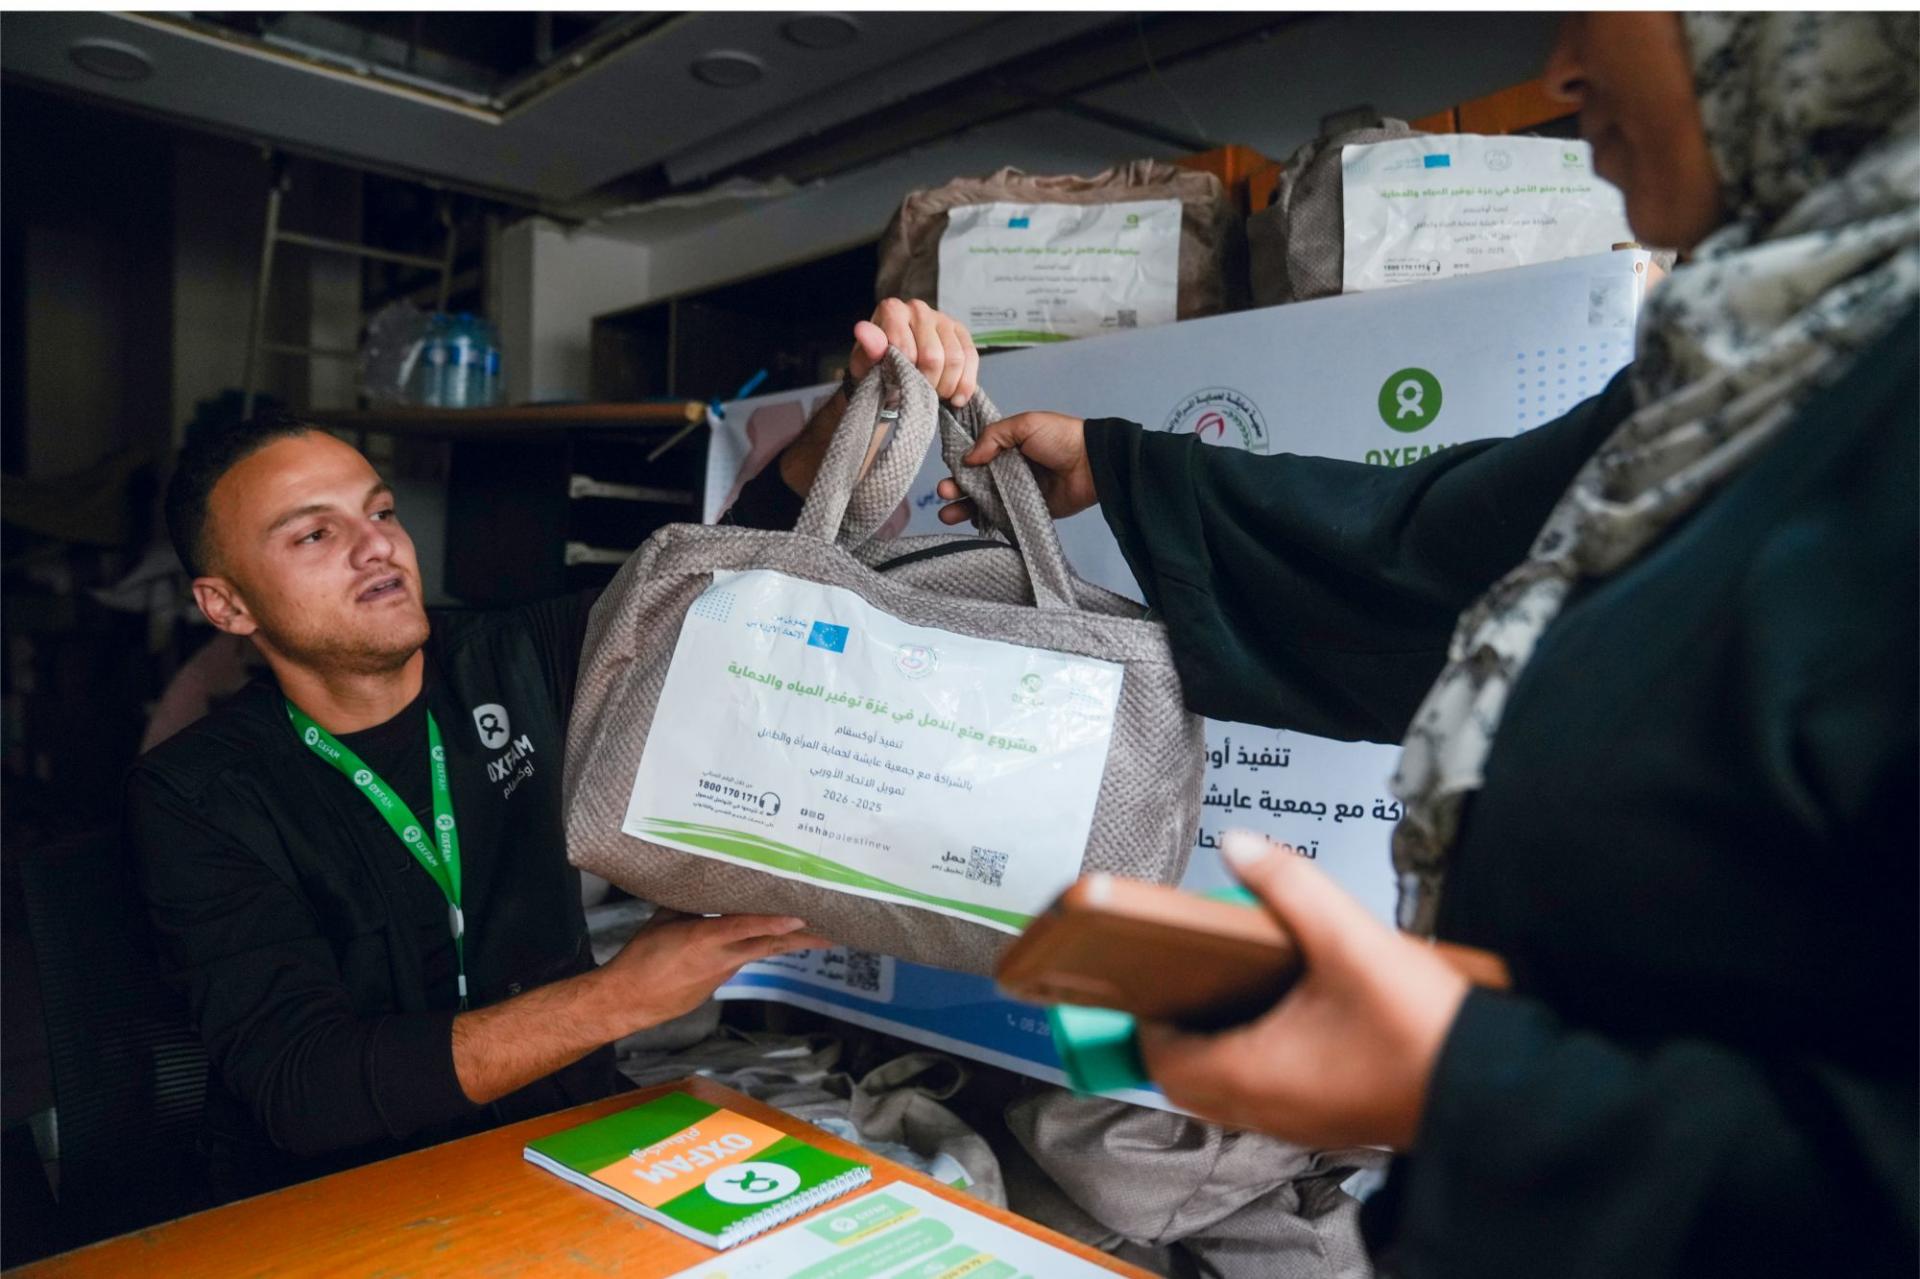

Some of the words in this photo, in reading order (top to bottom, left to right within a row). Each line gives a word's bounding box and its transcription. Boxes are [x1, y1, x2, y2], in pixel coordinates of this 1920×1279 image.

[1365, 443, 1458, 468] OXFA
[728, 660, 783, 690] والحماية
[787, 681, 824, 698] المياه
[825, 691, 862, 709] توفير
[865, 701, 889, 715] غزة
[891, 709, 914, 724] في
[835, 725, 877, 744] أوكسفام
[957, 725, 985, 742] صنع
[317, 740, 340, 759] OXFAM
[987, 736, 1038, 754] مشروع
[487, 734, 535, 783] OXFAM
[885, 760, 915, 776] جمعية
[1237, 746, 1291, 771] تنفيذ
[916, 770, 931, 781] مع
[368, 783, 394, 809] OXFAM
[699, 779, 721, 792] 1800
[723, 787, 740, 798] 170
[742, 792, 757, 803] 171
[823, 789, 849, 804] 2026
[877, 781, 906, 797] تمويل
[1202, 783, 1252, 813] عايش
[1259, 790, 1327, 821] جمعية
[1334, 804, 1364, 823] مع
[441, 831, 453, 862] OXFAM
[798, 823, 891, 851] aishapalestinew
[415, 841, 439, 867] OXFAM
[941, 851, 966, 864] حمل
[632, 1133, 753, 1185] OXFAM
